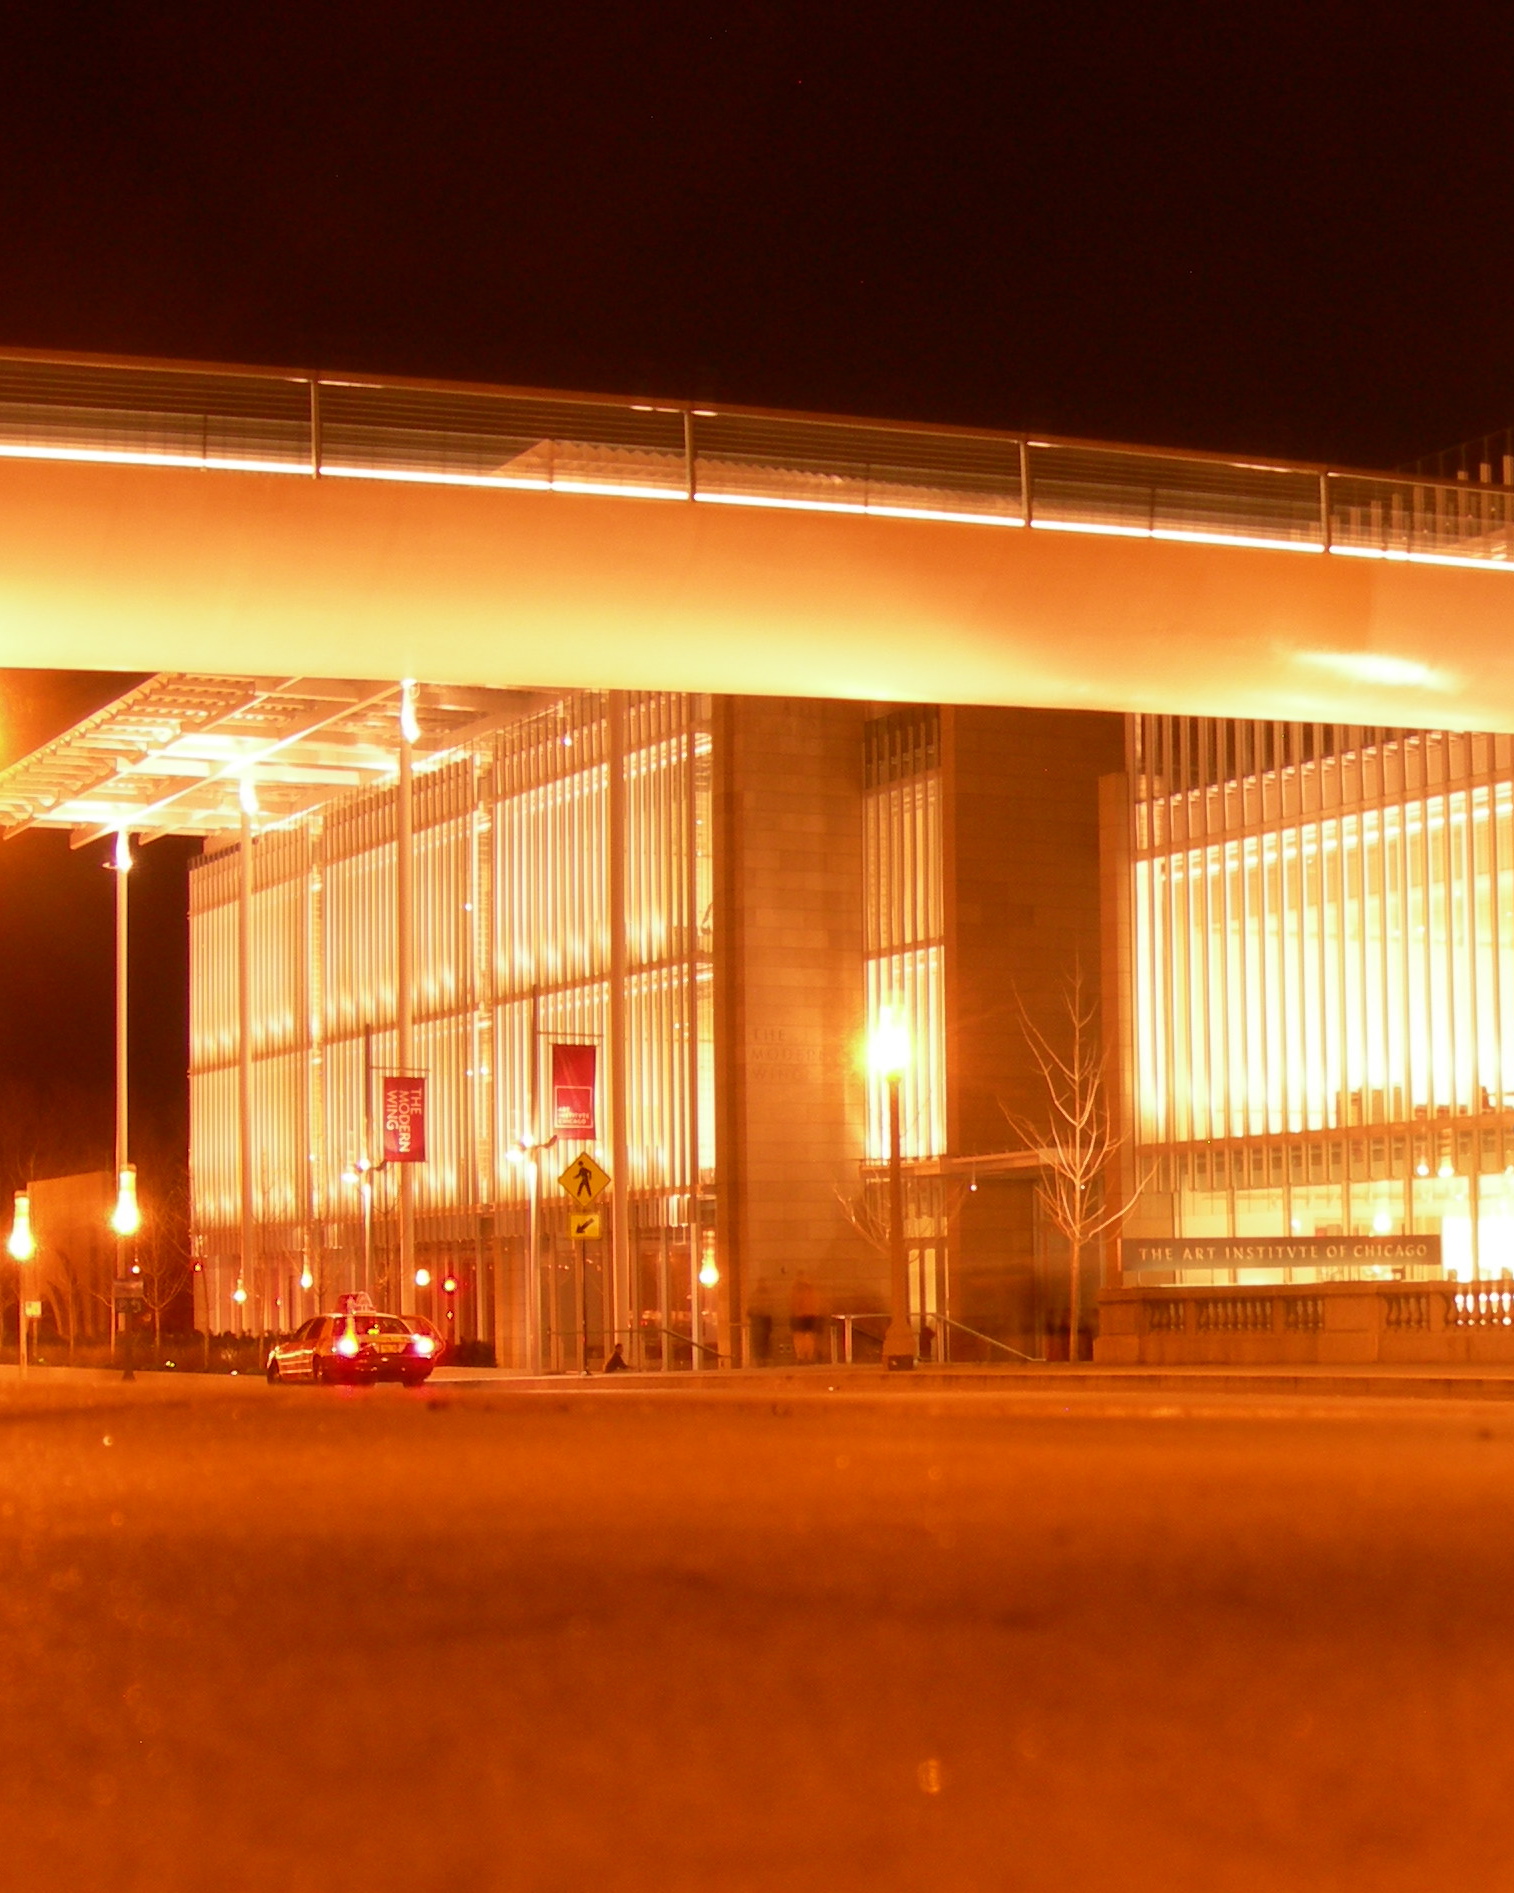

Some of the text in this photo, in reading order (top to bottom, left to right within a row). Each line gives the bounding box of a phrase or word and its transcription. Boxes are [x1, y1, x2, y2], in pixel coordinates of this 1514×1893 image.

[386, 1089, 399, 1131] WING
[410, 1088, 422, 1115] THE
[398, 1089, 411, 1153] MODERN
[1138, 1244, 1428, 1261] THE ART INSTITVTE OF CHICAGO
